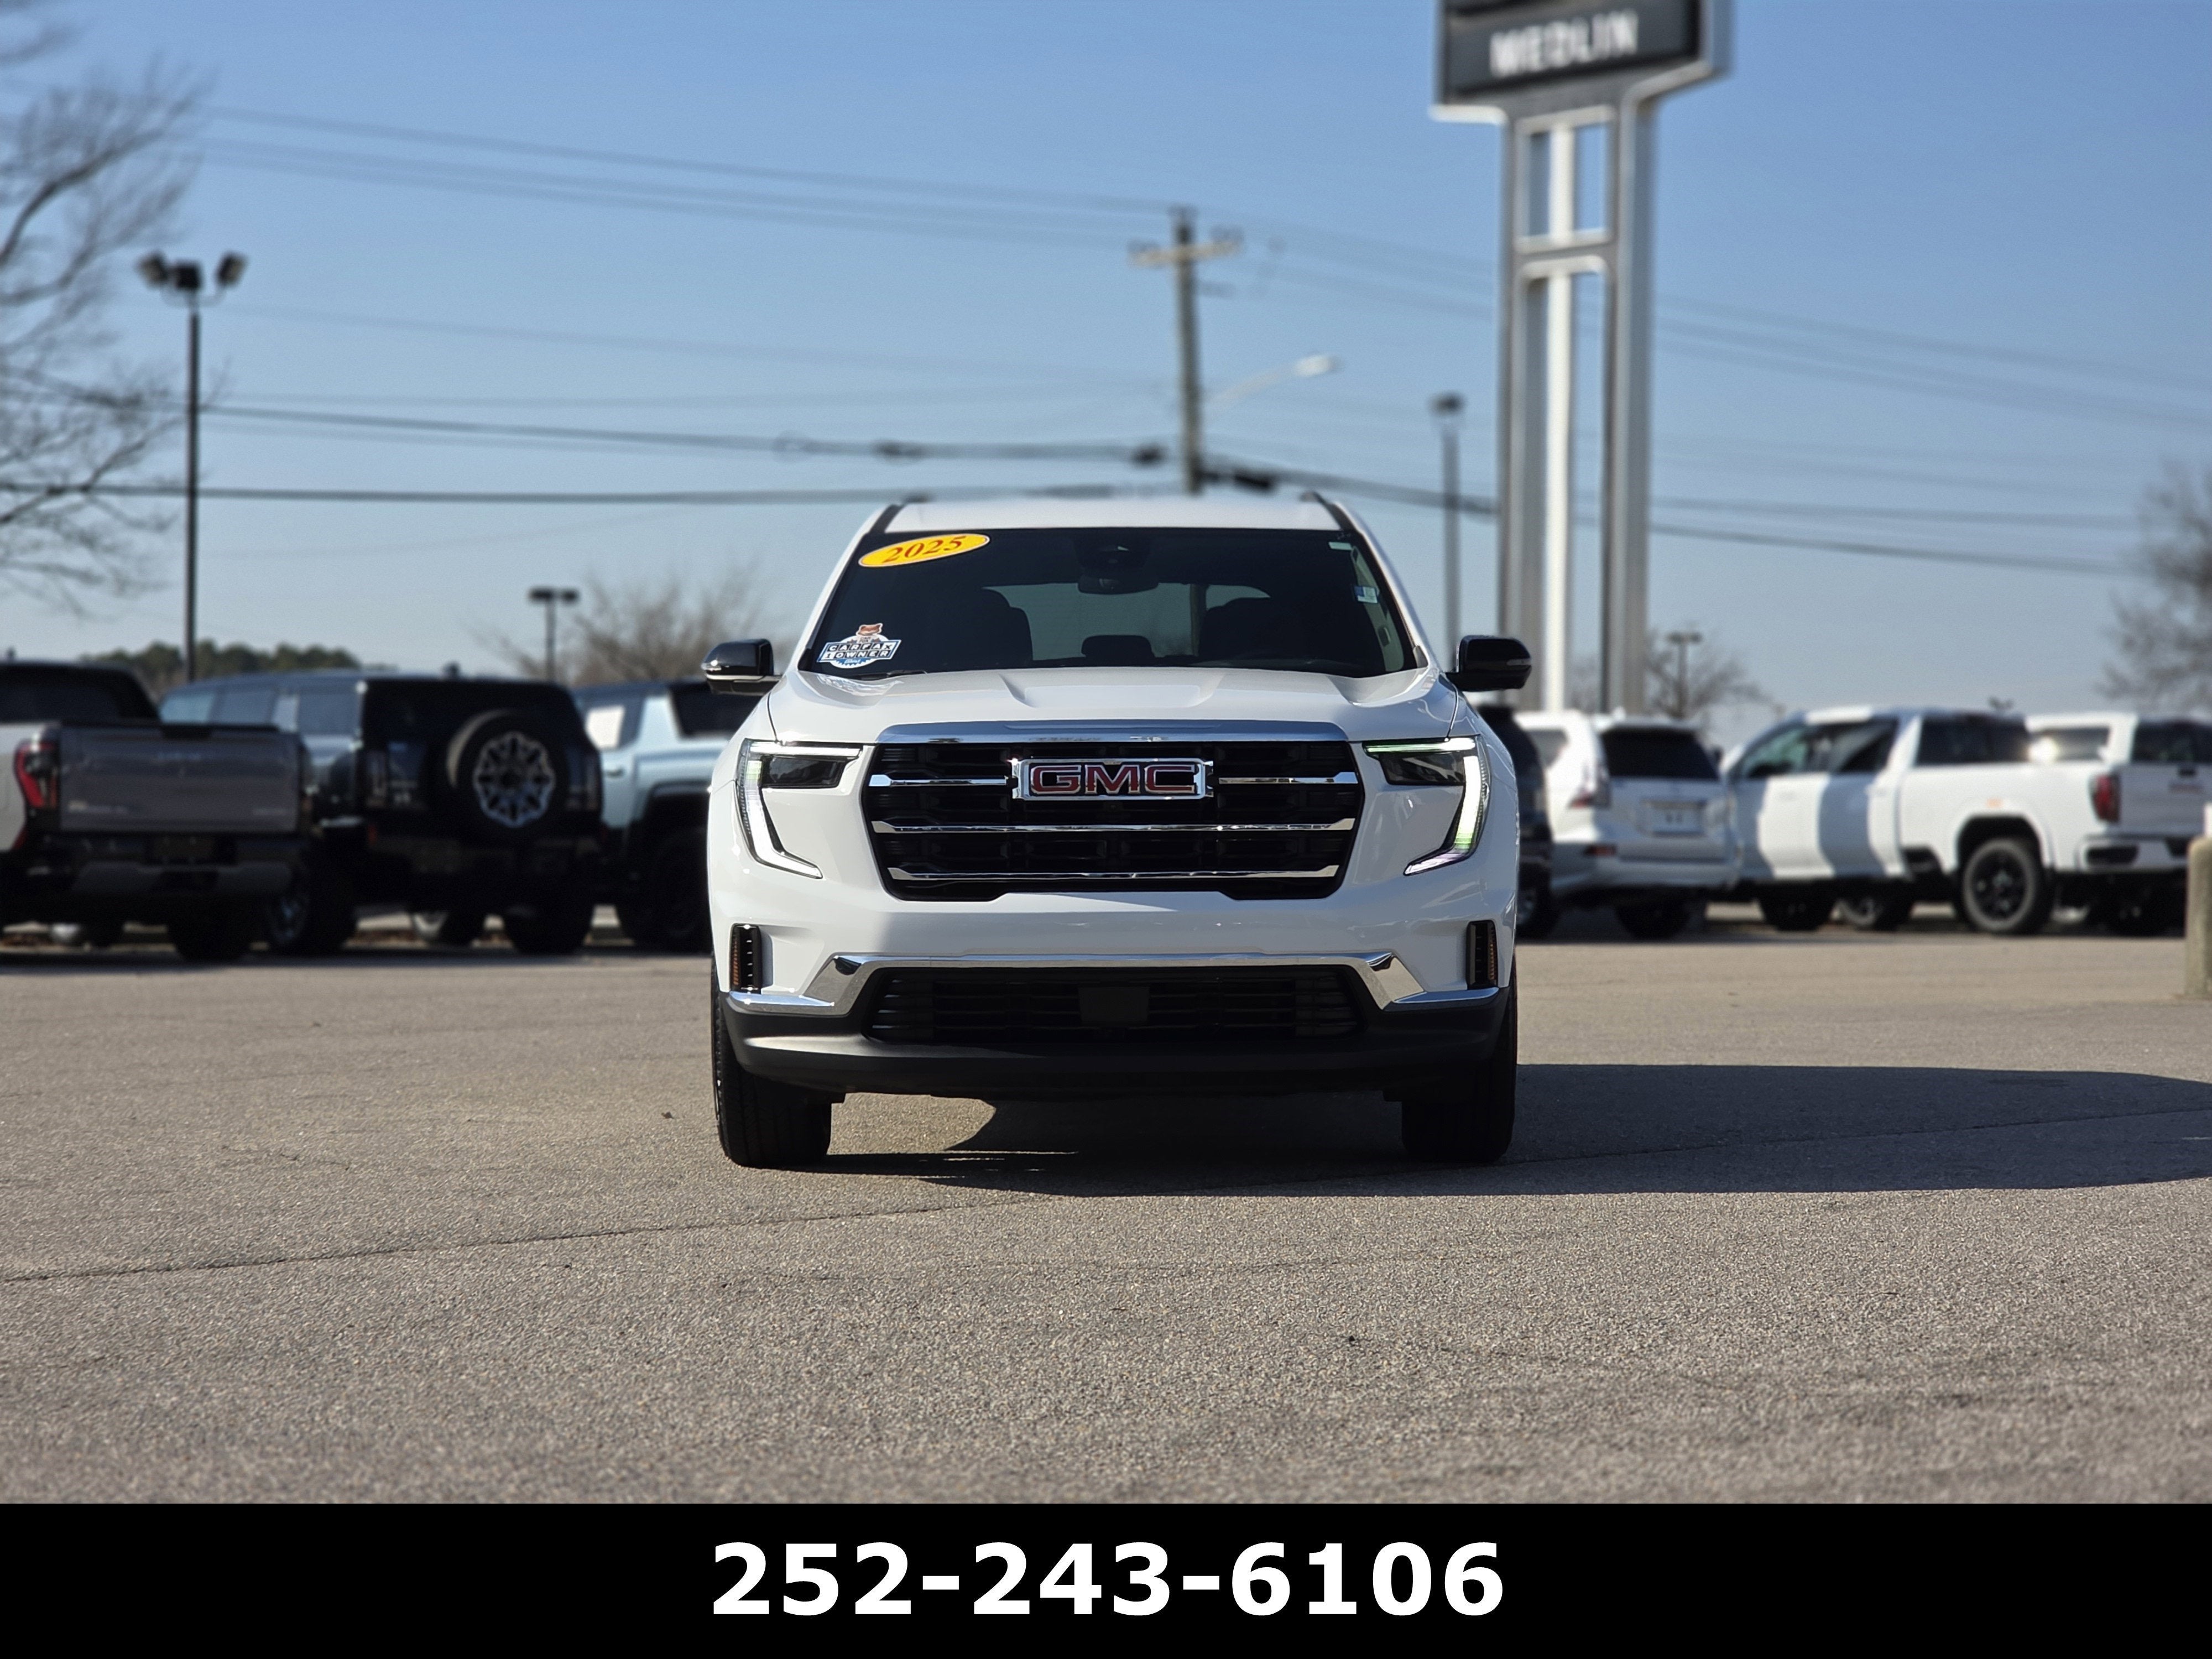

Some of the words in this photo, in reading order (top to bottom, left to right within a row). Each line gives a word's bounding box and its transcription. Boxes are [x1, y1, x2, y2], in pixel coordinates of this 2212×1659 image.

[1490, 10, 1638, 77] MEDLIN
[881, 535, 967, 564] 2025
[828, 643, 893, 651] CARFAX
[836, 650, 889, 659] OWNER
[1030, 764, 1196, 795] GMC
